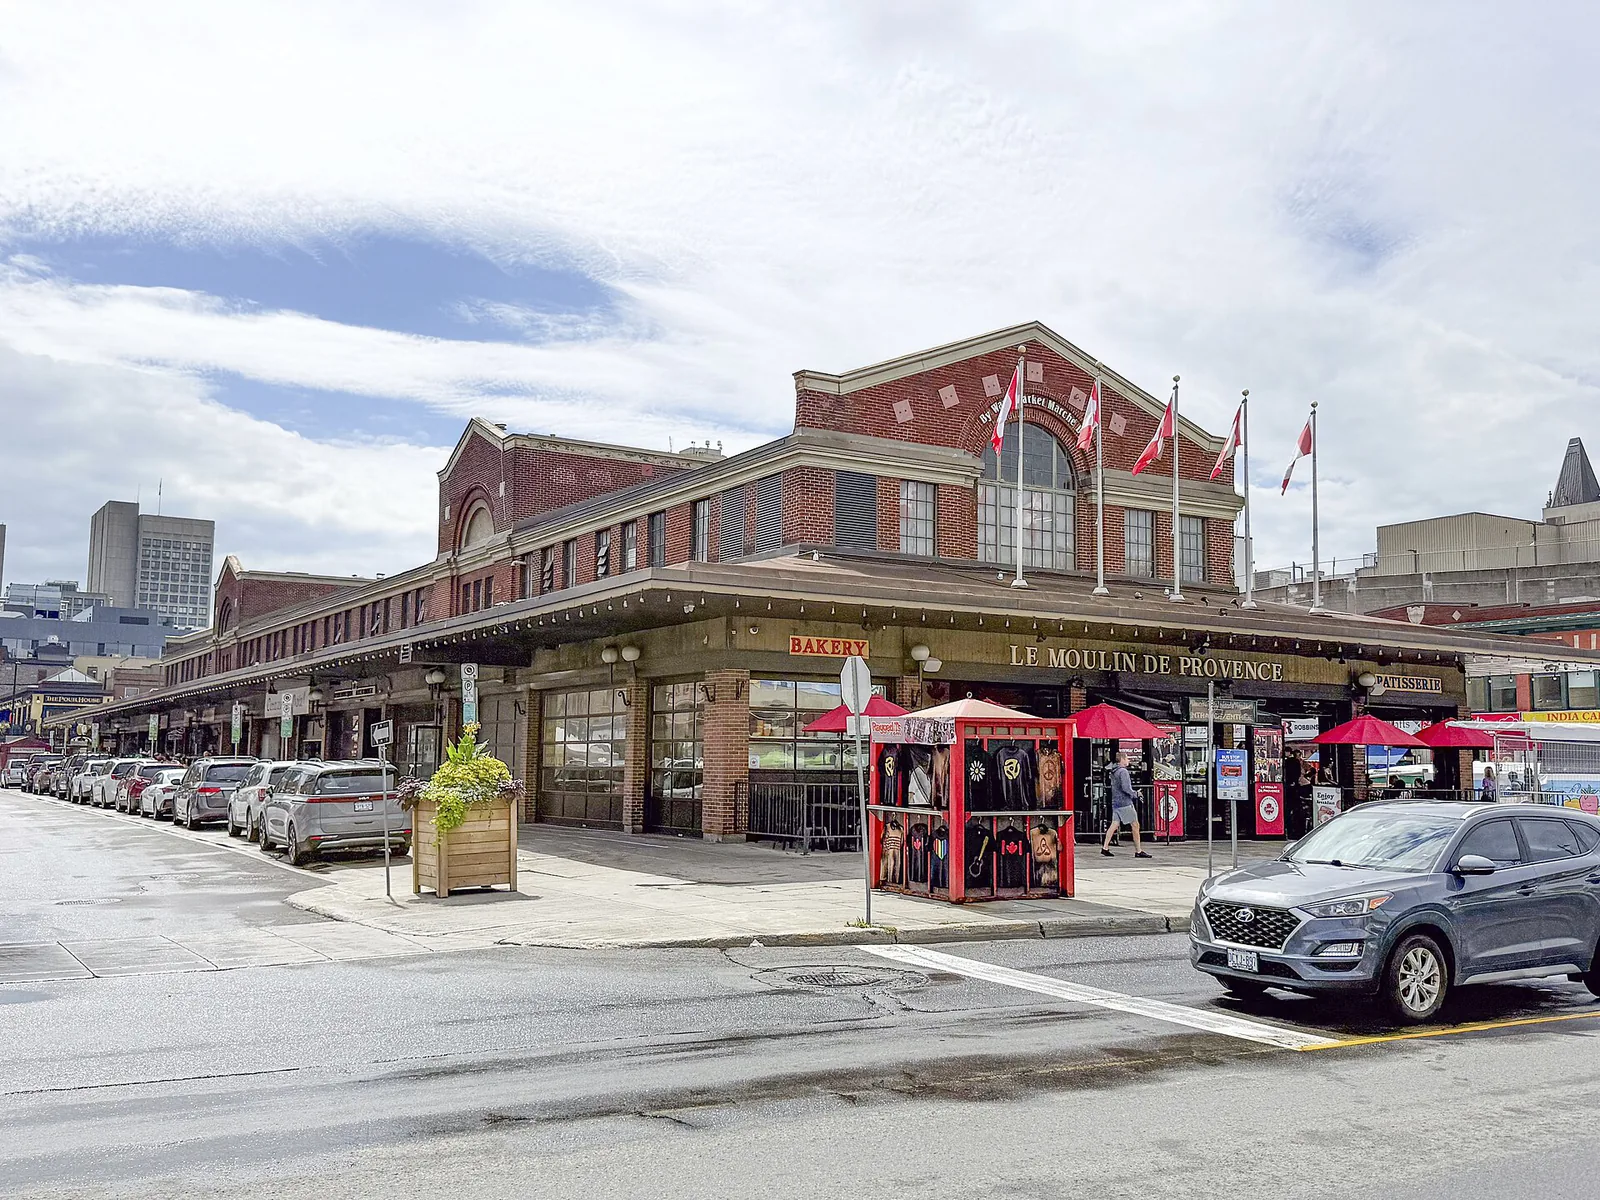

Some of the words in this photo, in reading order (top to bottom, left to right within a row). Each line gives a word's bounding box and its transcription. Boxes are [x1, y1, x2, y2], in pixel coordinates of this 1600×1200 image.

[979, 411, 992, 424] By
[1018, 394, 1046, 407] arket
[790, 637, 867, 657] BAKERY
[1009, 644, 1039, 667] LE
[1047, 647, 1137, 673] MOULIN
[1142, 654, 1171, 675] DE
[1178, 656, 1283, 682] PROVENCE
[1375, 675, 1441, 691] PATISSERIE
[1546, 711, 1579, 722] INDIA
[1582, 711, 1600, 721] CA
[1316, 792, 1334, 801] Enjoy
